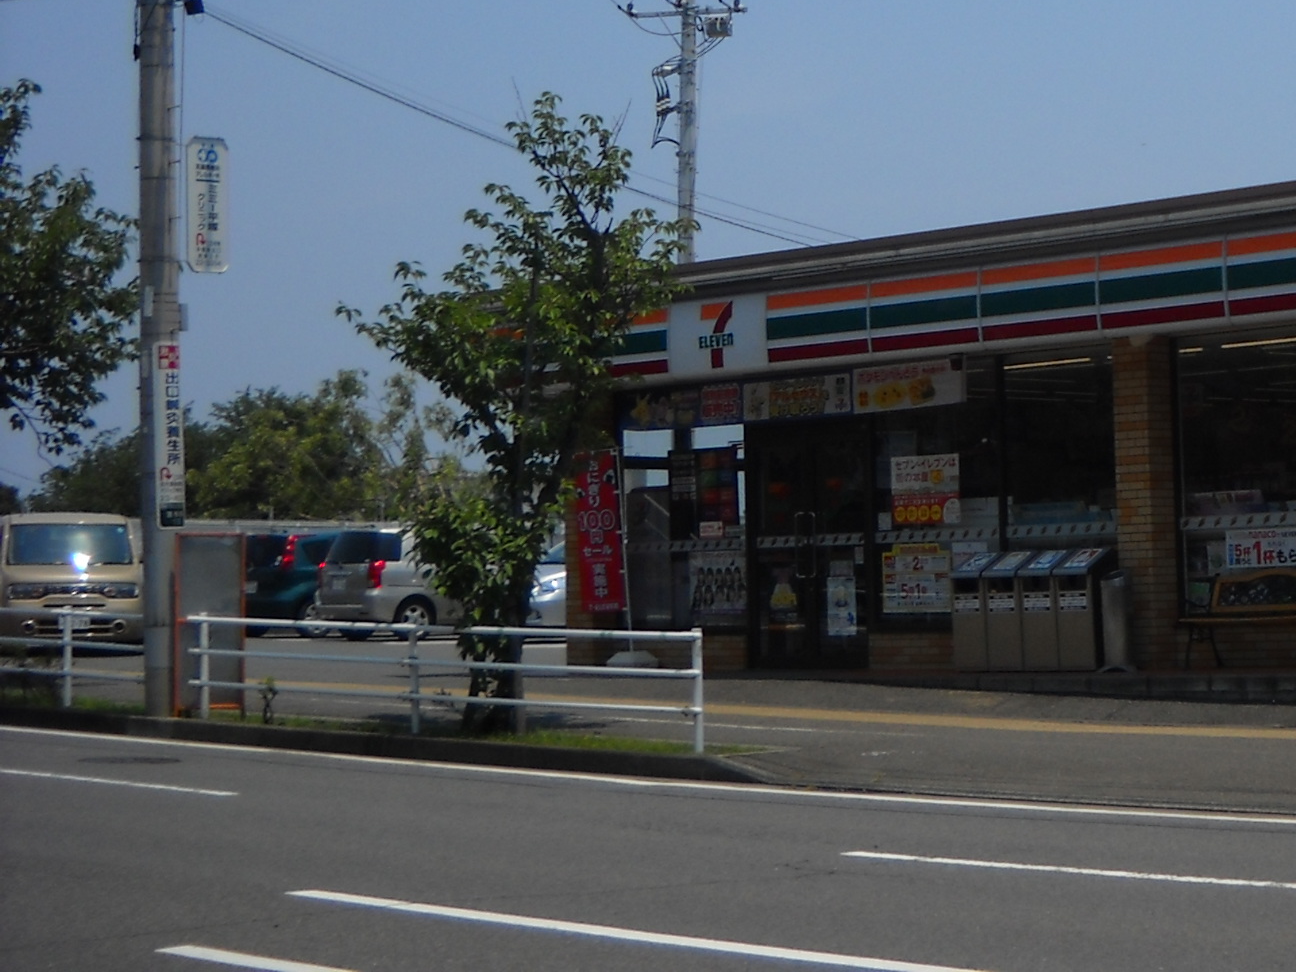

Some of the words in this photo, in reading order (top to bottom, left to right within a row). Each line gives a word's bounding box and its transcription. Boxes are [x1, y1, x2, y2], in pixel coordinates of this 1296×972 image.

[588, 460, 602, 508] おにぎり
[578, 510, 616, 532] 100
[583, 544, 614, 558] セール
